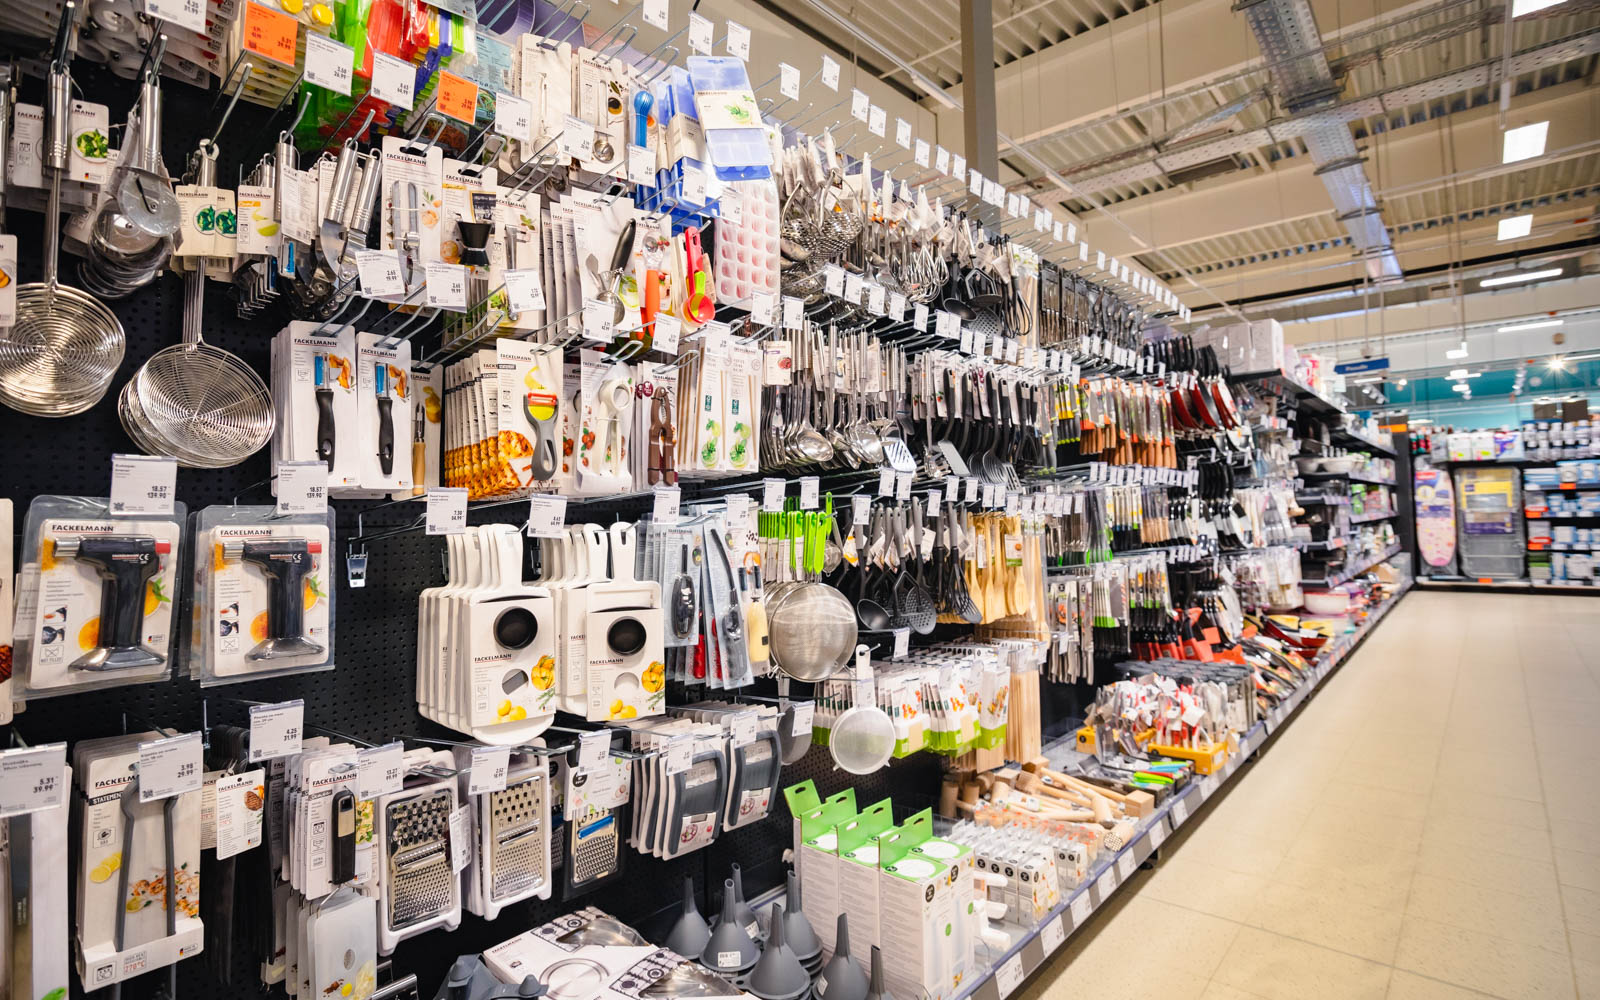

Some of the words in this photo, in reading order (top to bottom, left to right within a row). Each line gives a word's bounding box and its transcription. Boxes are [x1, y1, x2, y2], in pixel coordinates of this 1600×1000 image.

[386, 153, 427, 166] FACKELMANN
[446, 174, 483, 186] FACKELMANN
[294, 338, 337, 347] FACKELMANN
[360, 348, 398, 358] FACKELMANN
[500, 353, 532, 361] FACKELMANN
[52, 524, 114, 532] FACKELMANN
[474, 653, 512, 663] FACKELMANN
[284, 733, 297, 742] 31.99
[177, 769, 194, 778] 29.99
[40, 777, 54, 785] 5.31
[312, 773, 357, 786] FACKELMANN
[33, 784, 54, 794] 39.99
[218, 780, 254, 792] FACKELMANN
